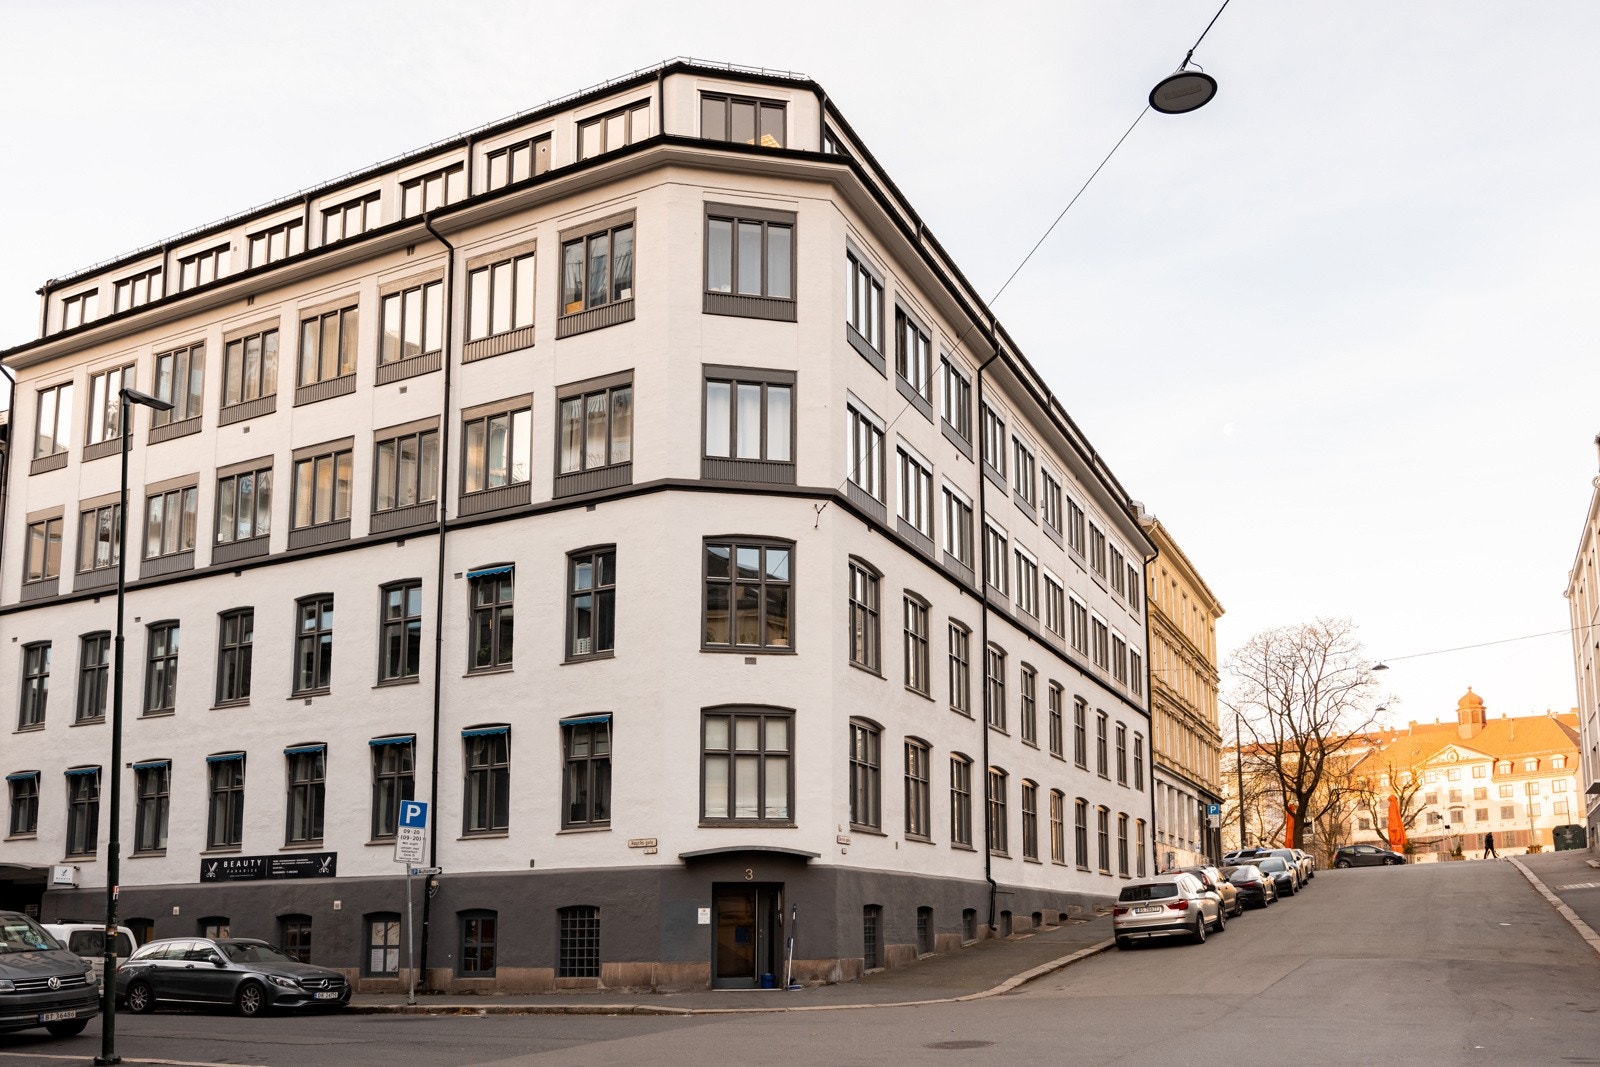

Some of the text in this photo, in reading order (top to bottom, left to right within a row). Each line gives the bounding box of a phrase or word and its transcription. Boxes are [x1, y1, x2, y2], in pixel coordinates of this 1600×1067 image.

[405, 804, 421, 824] P
[1210, 805, 1217, 814] P
[223, 859, 262, 868] BEAUTY
[745, 868, 754, 881] 3
